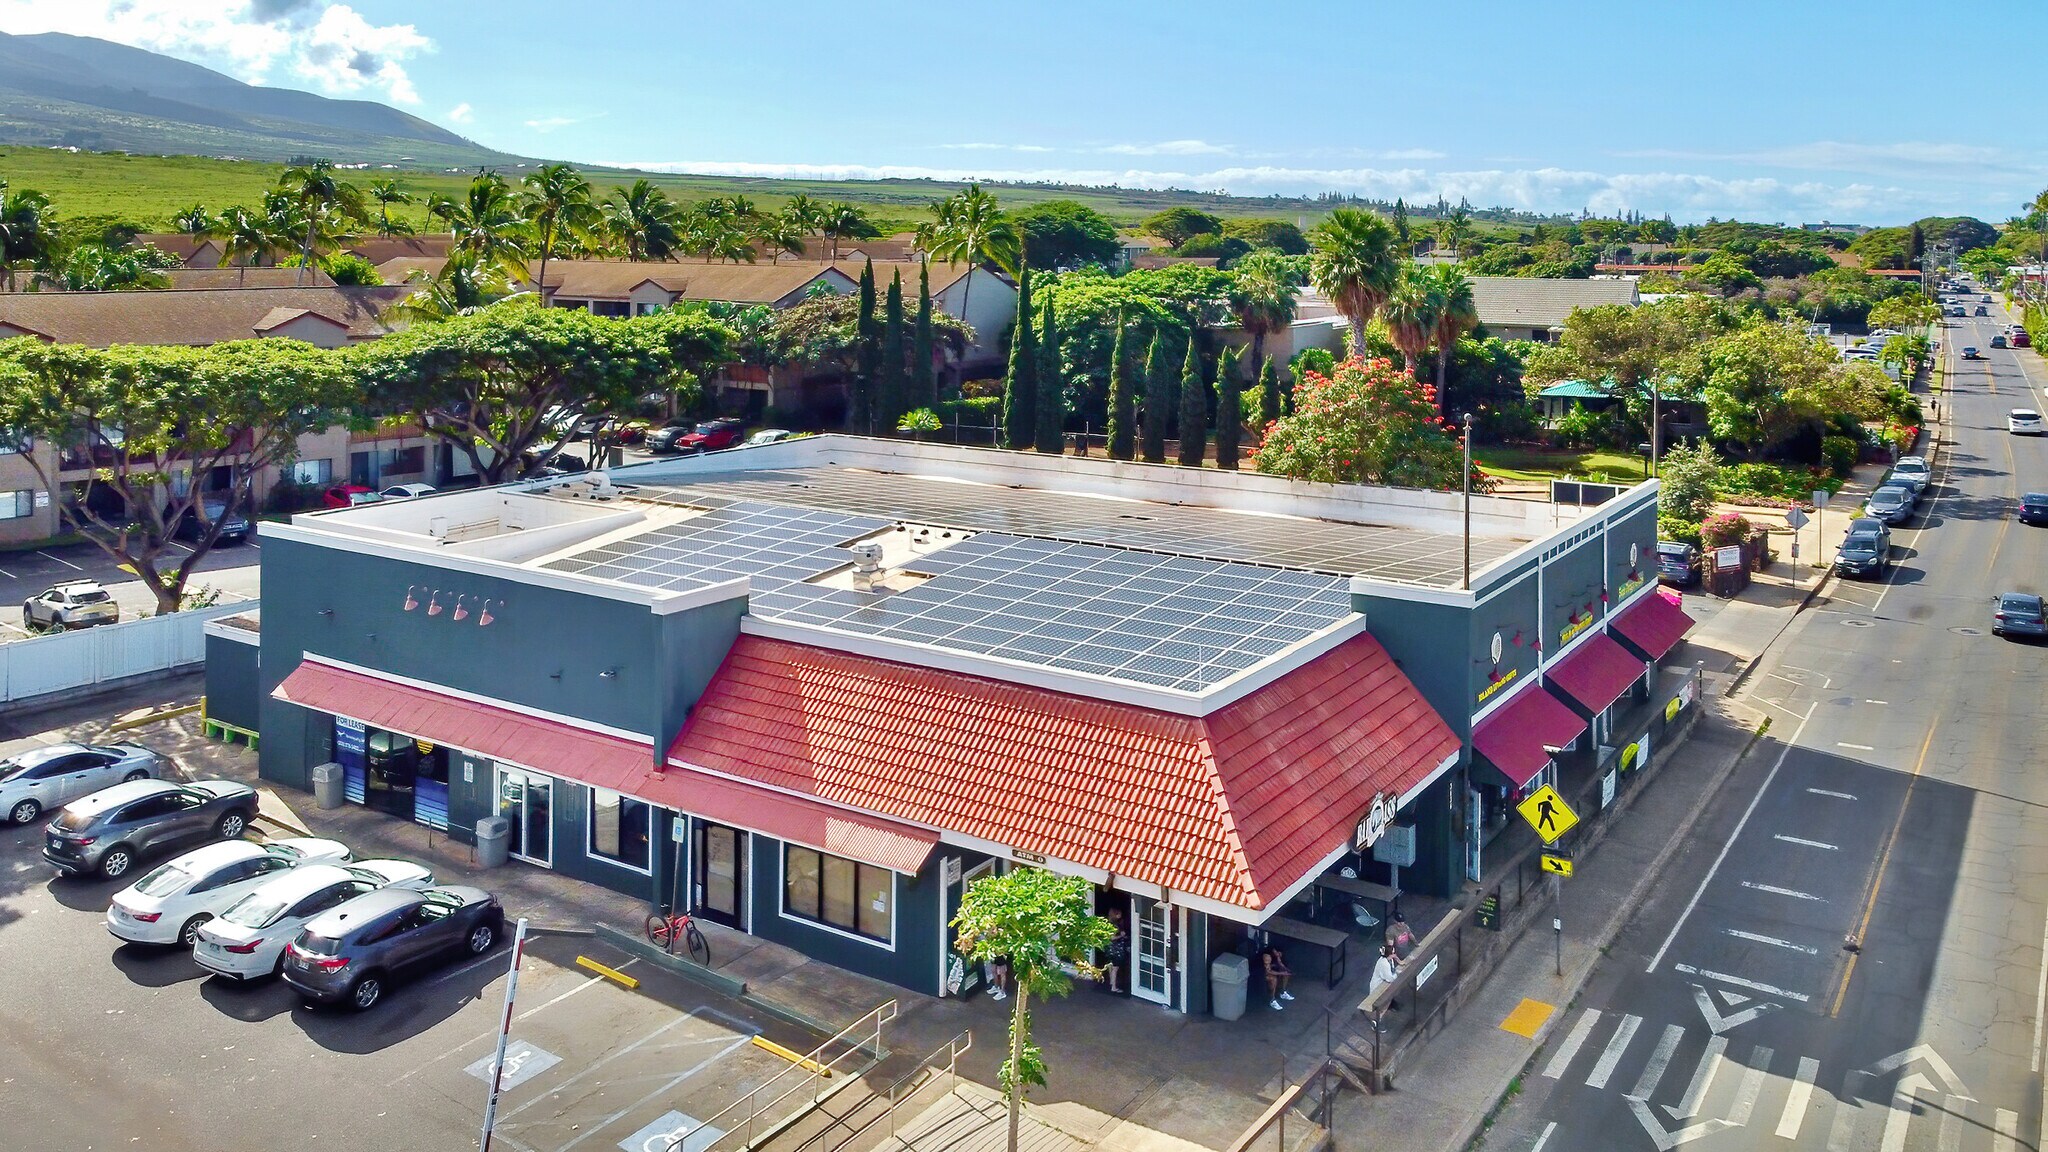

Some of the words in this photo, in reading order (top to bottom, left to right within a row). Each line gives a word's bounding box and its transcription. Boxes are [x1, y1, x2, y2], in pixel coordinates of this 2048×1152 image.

[337, 716, 348, 726] FOR
[349, 719, 366, 731] LEASE
[1017, 851, 1034, 861] ATM
